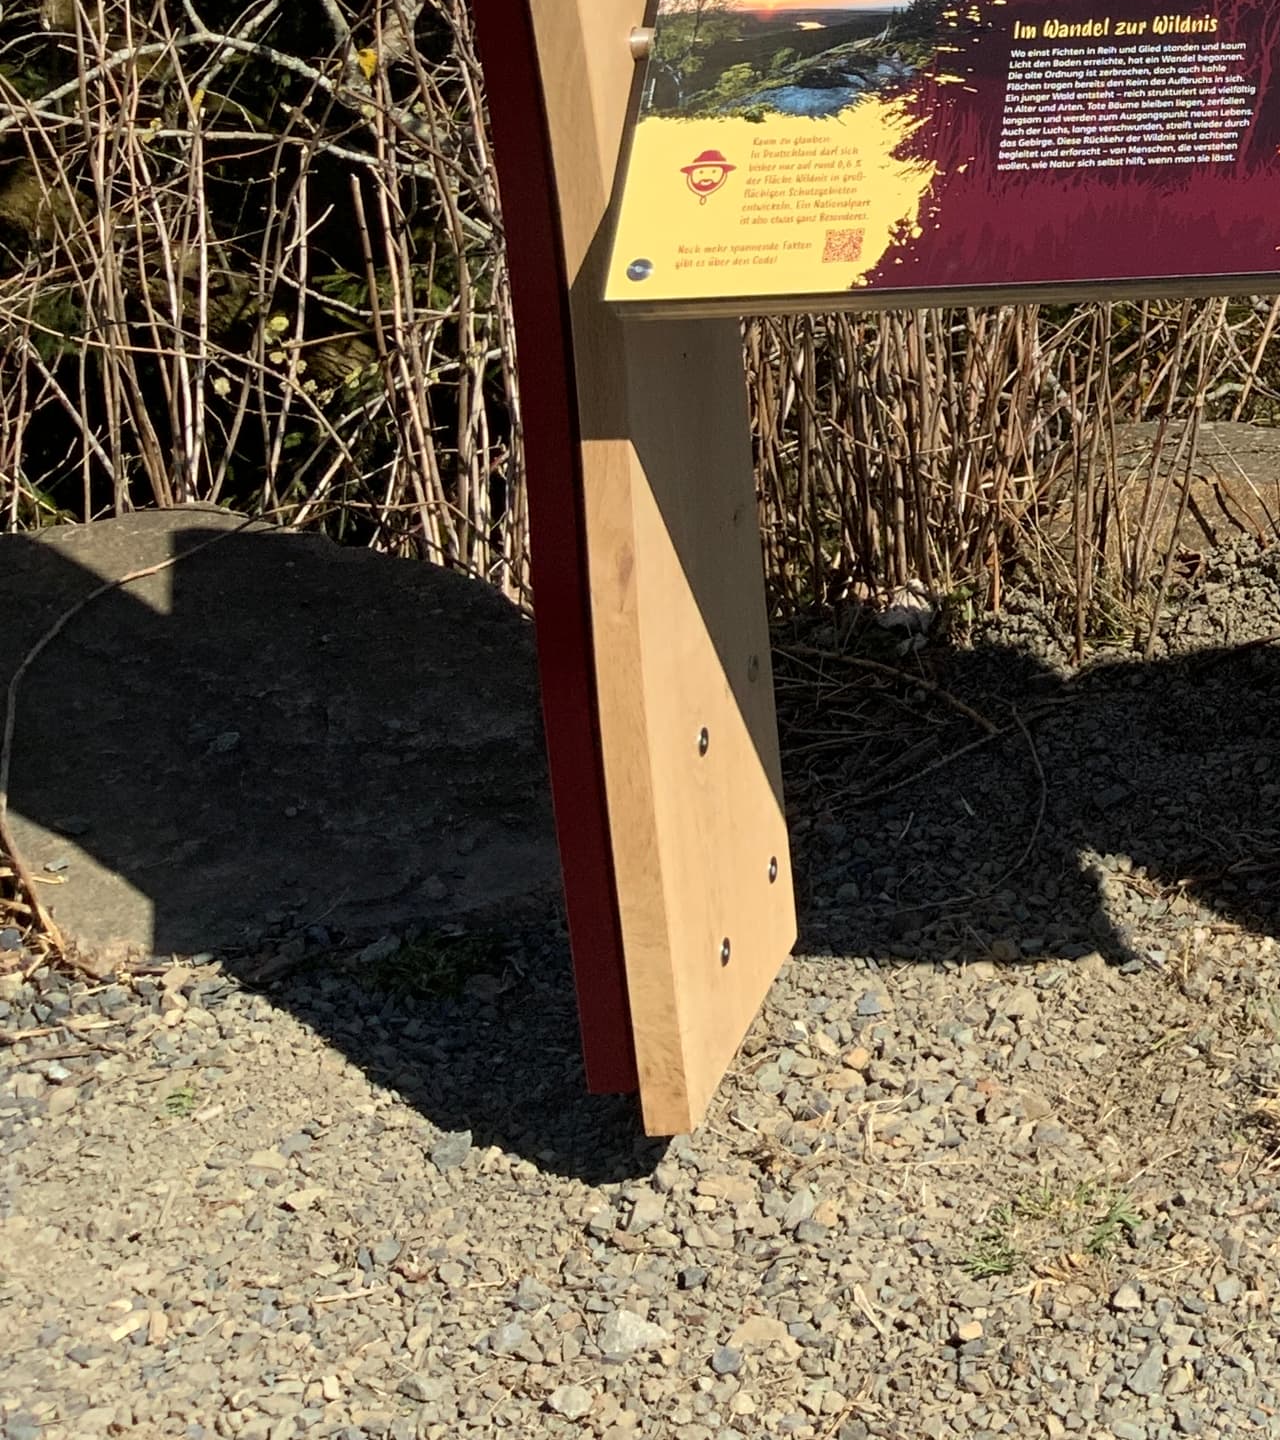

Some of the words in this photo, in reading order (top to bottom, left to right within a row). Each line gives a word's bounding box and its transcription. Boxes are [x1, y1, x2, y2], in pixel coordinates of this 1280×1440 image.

[1013, 20, 1038, 40] Im
[1042, 17, 1110, 39] Wandel
[1114, 20, 1147, 36] zur
[1152, 14, 1219, 35] Wildnis
[1011, 48, 1026, 58] Wo
[1026, 47, 1050, 58] einst
[1050, 46, 1085, 57] Fichten
[1085, 46, 1095, 56] in
[1096, 45, 1117, 55] Reih
[1117, 45, 1136, 55] und
[1137, 44, 1161, 54] Glied
[1162, 43, 1199, 53] standen
[1200, 42, 1219, 52] und
[1219, 41, 1246, 51] kaum
[1009, 59, 1031, 69] Licht
[1032, 58, 1051, 68] den
[1051, 57, 1081, 68] Boden
[1082, 56, 1126, 68] erreichte,
[1126, 55, 1143, 65] hat
[1144, 54, 1159, 64] ein
[1160, 53, 1195, 64] Wandel
[1196, 52, 1245, 65] begonnen.
[1008, 70, 1023, 80] Die
[1023, 69, 1043, 79] alte
[1043, 68, 1084, 81] Ordnung
[1085, 67, 1097, 77] ist
[1098, 66, 1152, 79] zerbrochen,
[1152, 65, 1176, 75] doch
[1176, 64, 1200, 74] auch
[1201, 63, 1227, 73] kahle
[1006, 80, 1042, 91] Flächen
[1042, 79, 1073, 92] tragen
[1073, 78, 1105, 89] bereits
[1106, 78, 1124, 88] den
[1124, 77, 1148, 87] Keim
[1149, 76, 1166, 86] des
[1167, 75, 1213, 86] Aufbruchs
[1213, 74, 1223, 84] in
[1224, 74, 1245, 84] sich.
